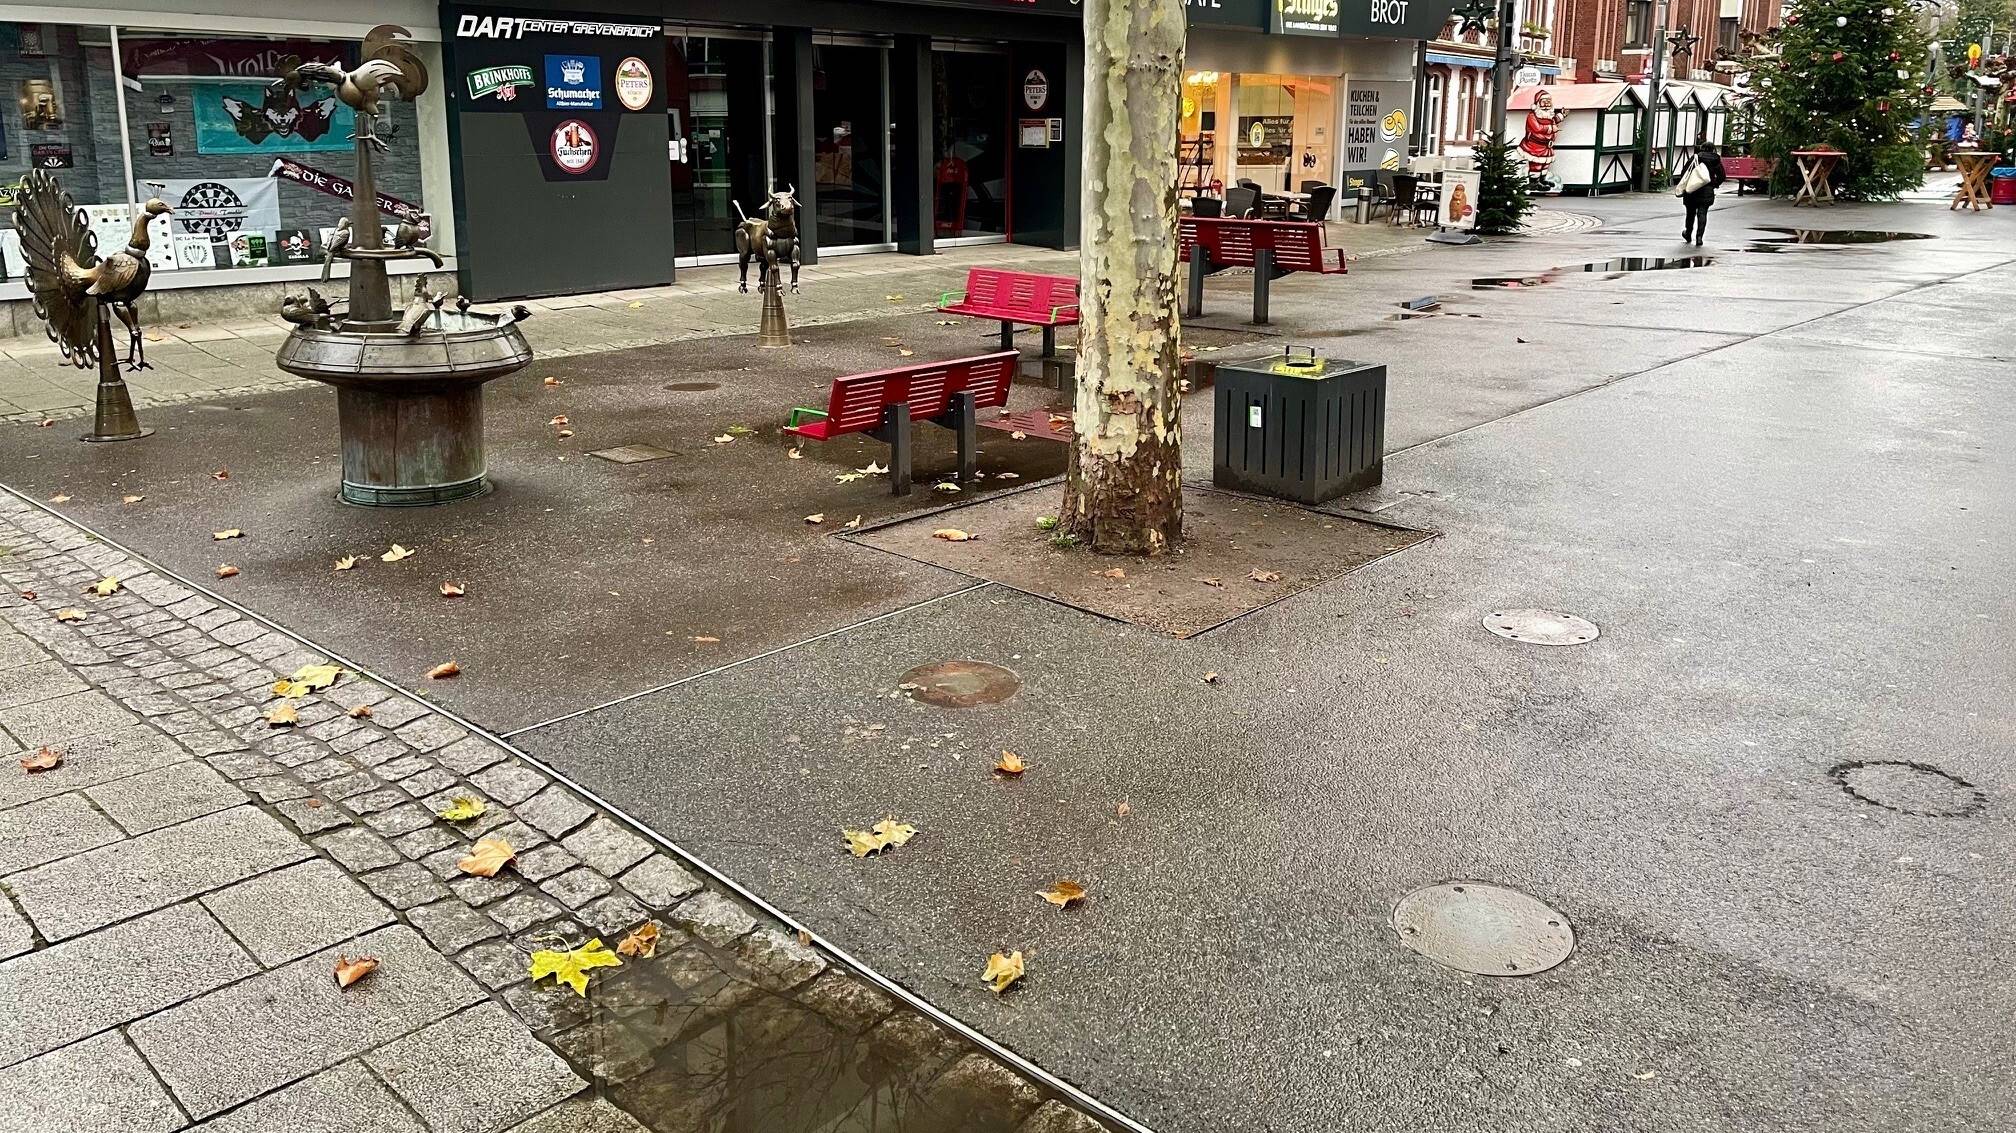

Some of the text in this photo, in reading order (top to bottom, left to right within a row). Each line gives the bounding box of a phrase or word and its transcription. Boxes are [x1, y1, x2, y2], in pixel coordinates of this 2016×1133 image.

[1370, 0, 1409, 24] BROT
[456, 15, 526, 39] DART
[522, 19, 568, 33] CENTER
[620, 79, 649, 88] PETERS
[547, 87, 601, 100] Schumacher
[1350, 90, 1380, 102] KUCHEN &
[1350, 104, 1378, 116] TEILCHEN
[1348, 127, 1376, 143] HABEN
[1347, 147, 1368, 162] WIR!
[332, 182, 393, 211] GAER
